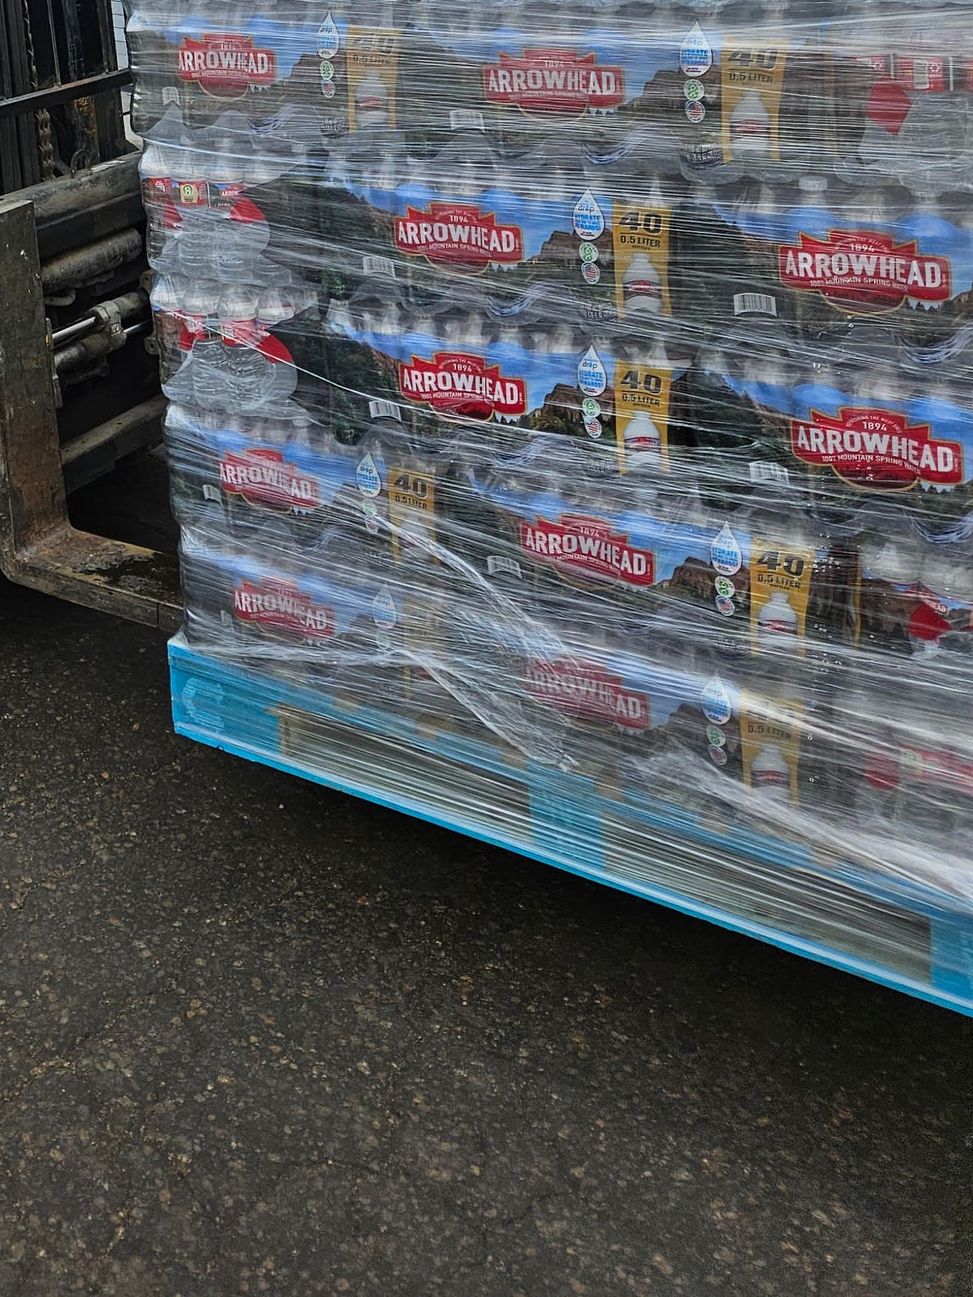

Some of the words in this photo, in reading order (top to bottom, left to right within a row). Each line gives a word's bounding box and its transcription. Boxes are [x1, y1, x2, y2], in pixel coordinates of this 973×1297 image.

[179, 50, 267, 74] ARROWHEAD
[727, 48, 778, 70] 40
[488, 69, 615, 95] ARROWHEAD
[748, 73, 773, 83] LITER
[449, 214, 468, 222] 1894
[618, 211, 663, 235] 40
[398, 221, 515, 253] ARROWHEAD
[620, 235, 636, 244] 0.5
[637, 236, 660, 248] LITER
[850, 243, 875, 252] 1894
[785, 250, 941, 288] ARROWHEAD
[863, 277, 891, 287] SPRING
[453, 363, 472, 372] 1894
[403, 368, 519, 404] ARROWHEAD
[620, 370, 662, 395] 40
[862, 421, 887, 431] 1894
[797, 425, 953, 472] ARROWHEAD
[875, 455, 903, 466] SPRING
[394, 474, 428, 499] 40
[525, 527, 646, 575] ARROWHEAD
[757, 551, 805, 577] 40
[757, 573, 774, 583] 0.5
[775, 576, 801, 589] LITER
[747, 724, 764, 734] 0.5
